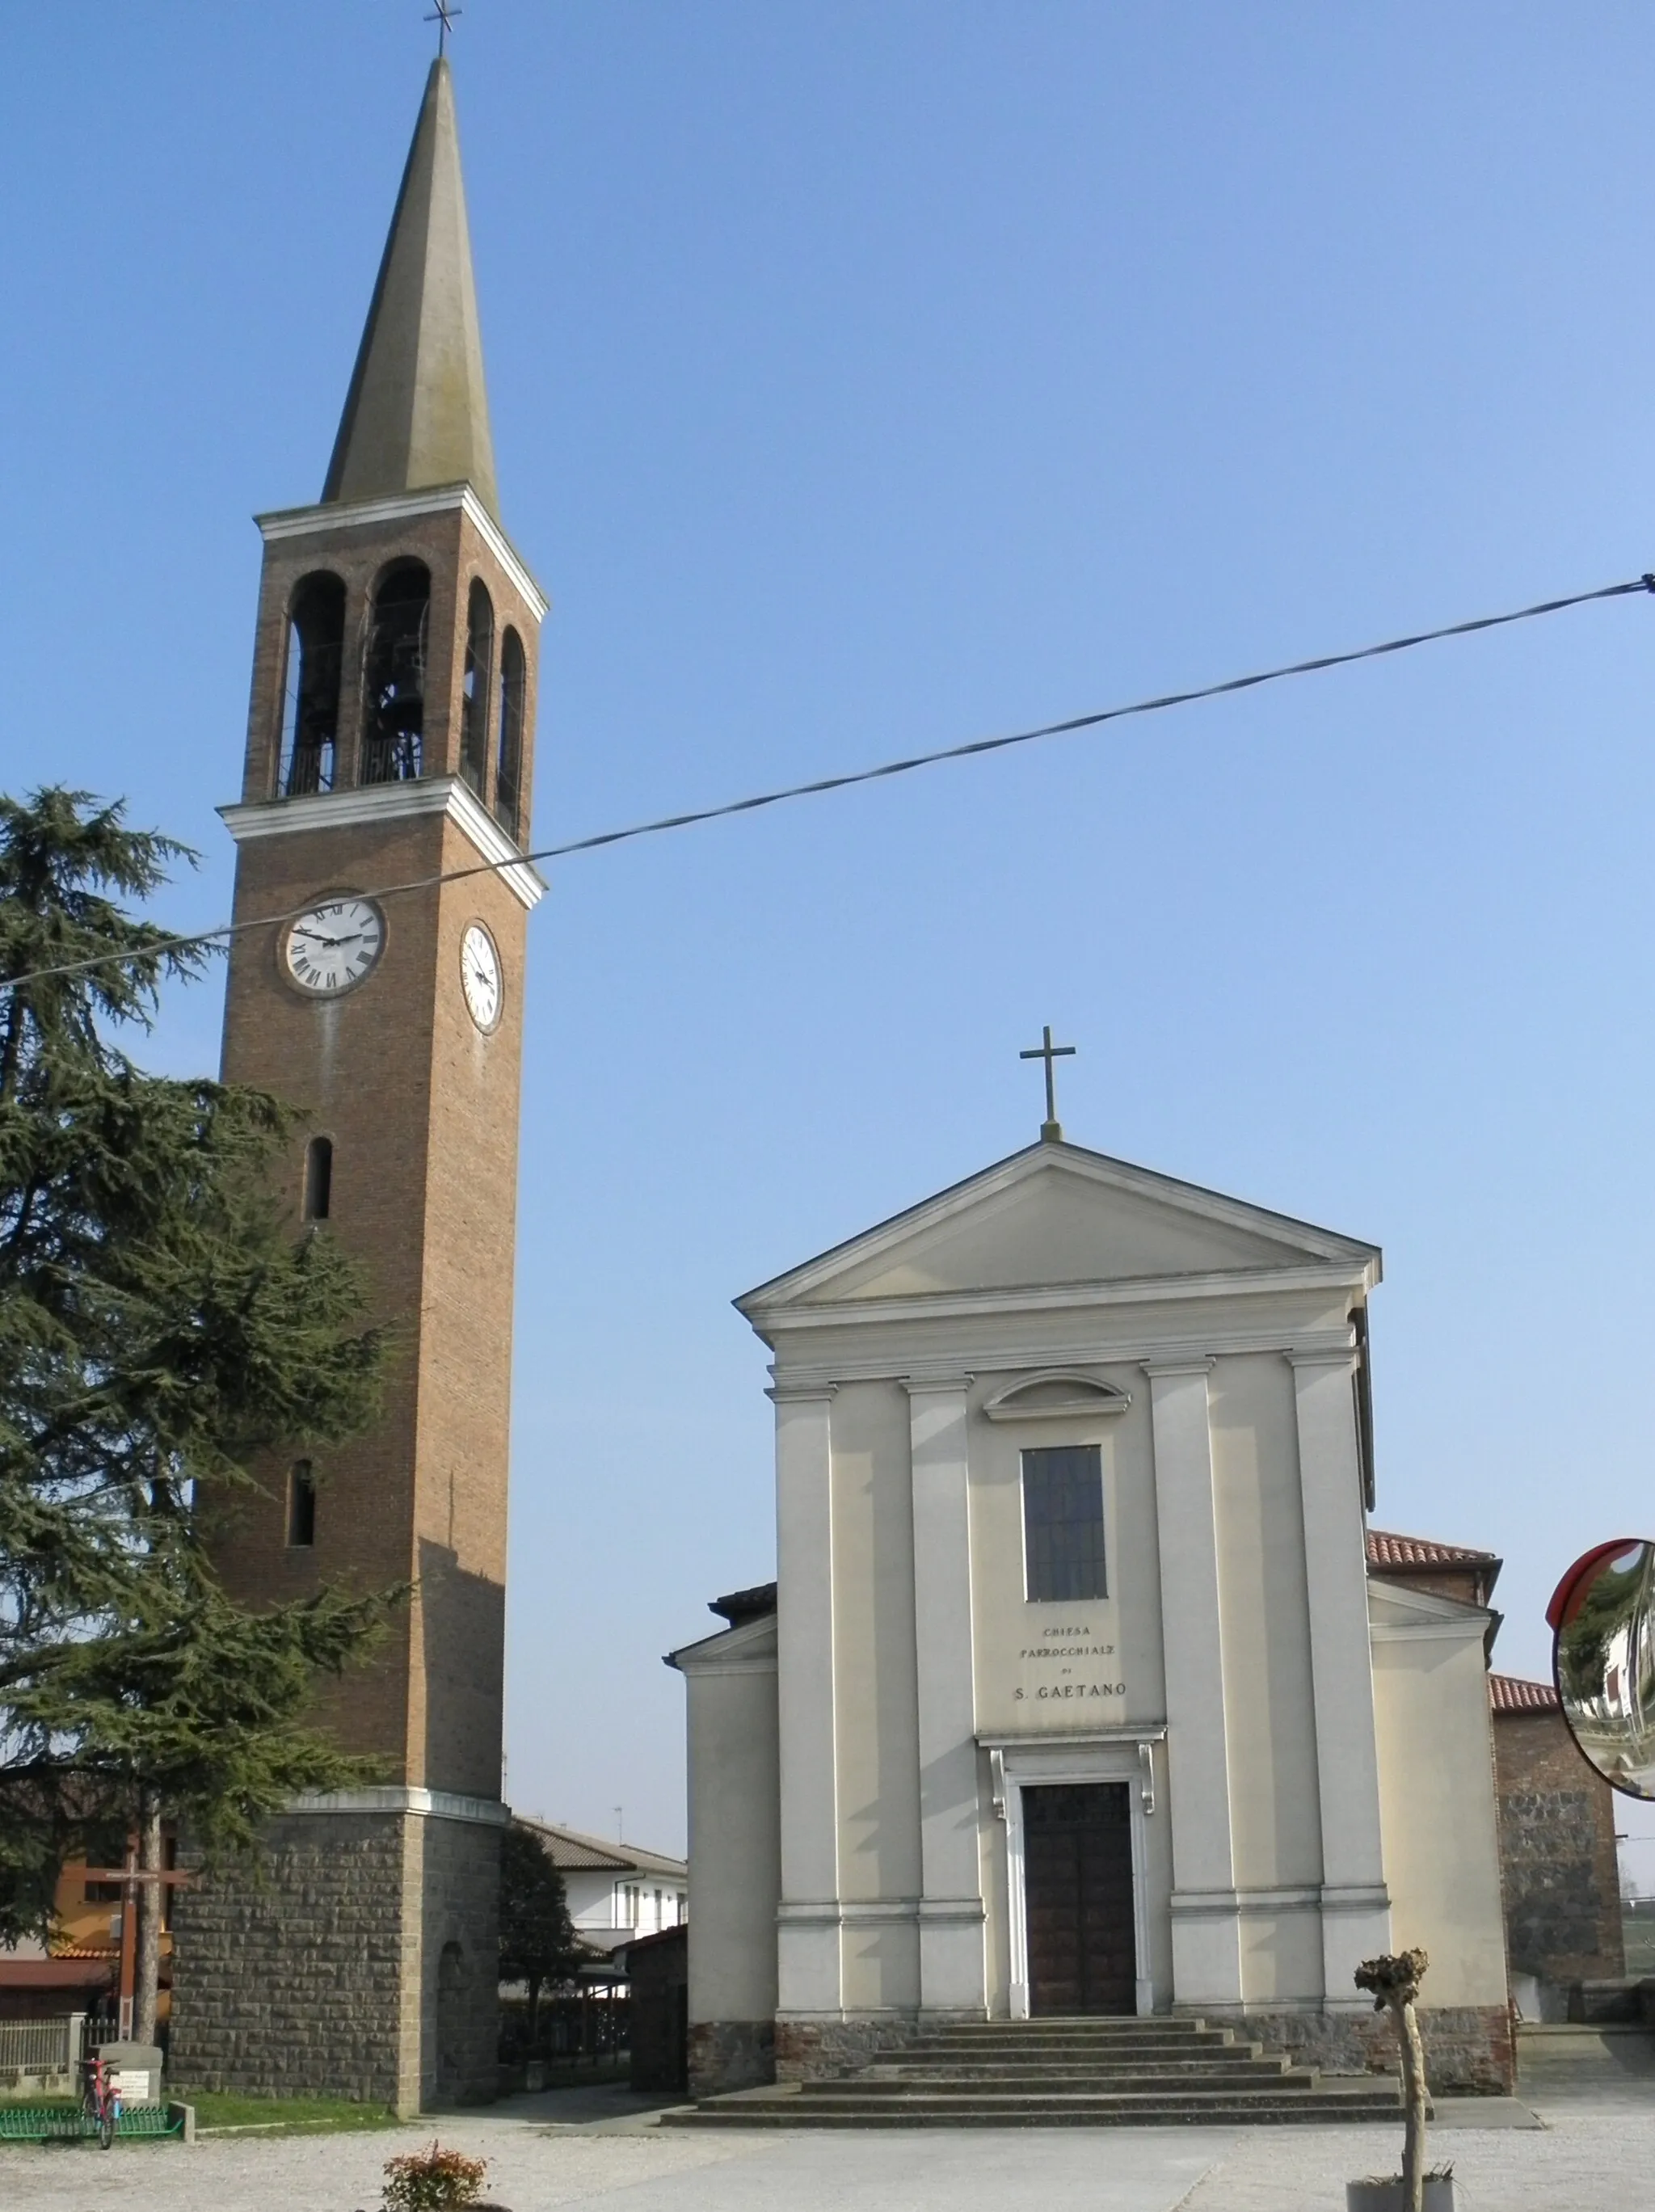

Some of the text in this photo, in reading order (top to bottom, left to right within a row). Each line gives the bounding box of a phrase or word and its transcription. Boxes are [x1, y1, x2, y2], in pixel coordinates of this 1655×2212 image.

[1043, 1627, 1090, 1637] CHIESA
[1020, 1645, 1115, 1658] PARROCCHIALE
[1015, 1683, 1126, 1700] S. GAETANO
